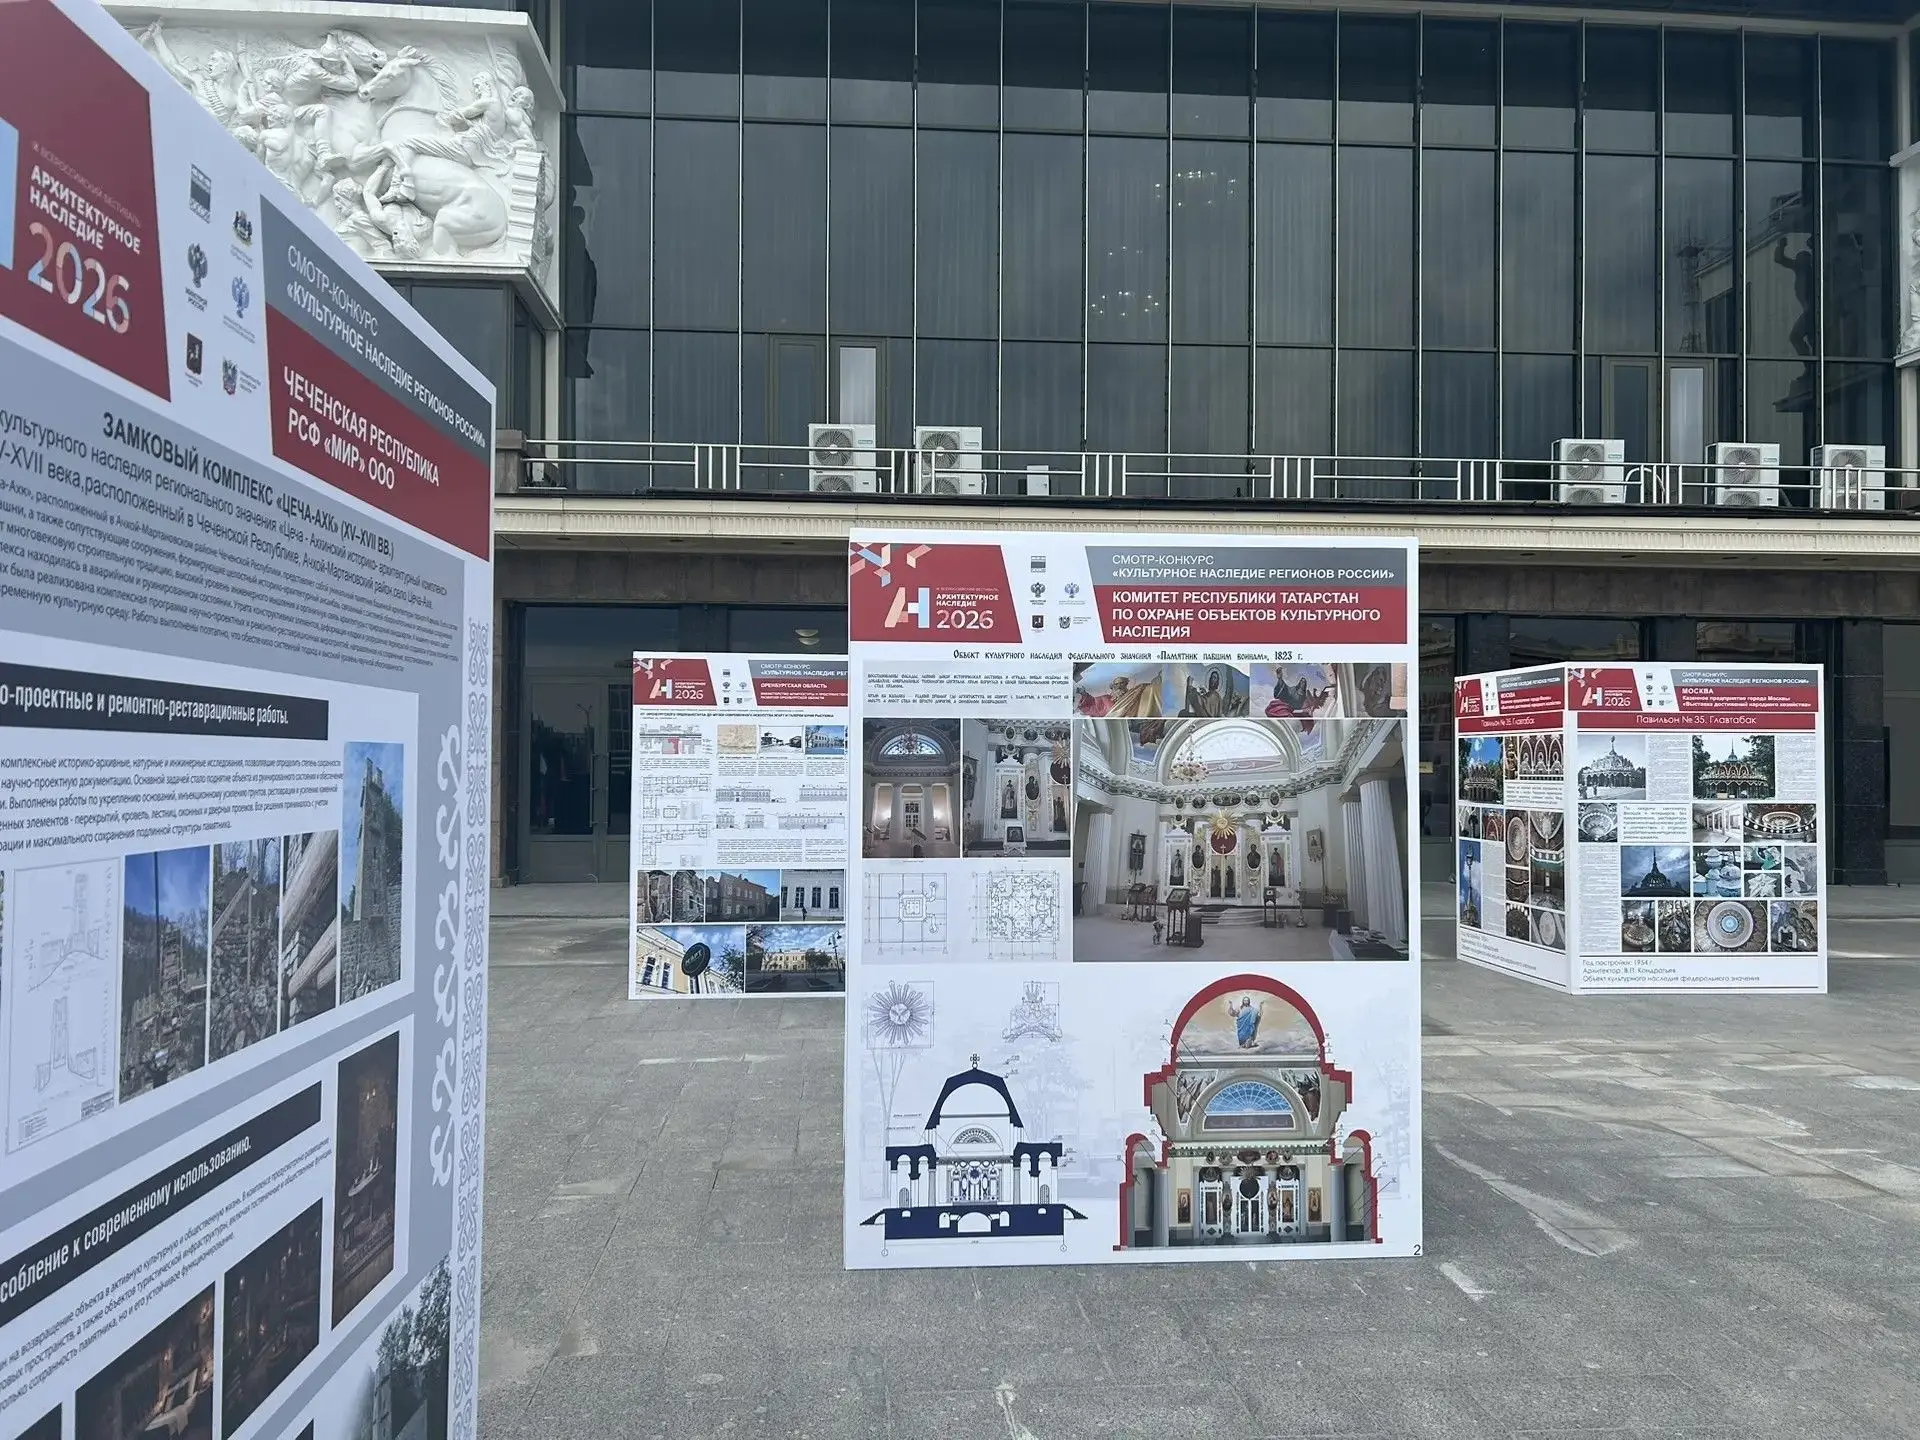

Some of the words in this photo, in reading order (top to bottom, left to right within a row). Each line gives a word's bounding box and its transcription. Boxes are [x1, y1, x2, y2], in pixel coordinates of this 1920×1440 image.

[30, 160, 140, 256] АРХИТЕКТУРНОЕ
[30, 184, 104, 253] НАСЛЕДИЕ
[27, 216, 129, 336] 2026
[287, 241, 377, 339] СМОТР-КОНКУРС
[287, 274, 363, 355] «КУЛЬТУРНОЕ
[365, 338, 412, 397] НАСЛЕДИЕ
[413, 378, 454, 426] РЕГИОНОВ
[455, 411, 485, 450] РОССИИ»
[284, 365, 366, 443] ЧЕЧЕНСКАЯ
[369, 422, 438, 487] РЕСПУБЛИКА
[287, 406, 320, 449] РСФ
[323, 428, 365, 474] «МИР»
[368, 454, 394, 491] ООО
[103, 409, 198, 475] ЗАМКОВЫЙ
[202, 455, 272, 507] КОМПЛЕКС
[276, 490, 337, 535] «ЦЕЧА-АХК»
[90, 446, 151, 487] наследия
[155, 472, 233, 518] регионального
[236, 505, 274, 531] значения
[36, 489, 107, 525] расположенный
[36, 511, 63, 528] также
[187, 512, 193, 527] в
[196, 512, 248, 546] Чеченской
[1112, 554, 1214, 565] СМОТР-КОНКУРС
[1112, 568, 1197, 578] «КУЛЬТУРНОЕ
[1200, 569, 1266, 579] НАСЛЕДИЕ
[1269, 569, 1334, 579] РЕГИОНОВ
[1338, 569, 1394, 579] РОССИИ»
[1112, 591, 1179, 603] КОМИТЕТ
[1182, 591, 1276, 604] РЕСПУБЛИКИ
[1280, 592, 1359, 604] ТАТАРСТАН
[936, 609, 994, 629] 2026
[1112, 608, 1133, 620] ПО
[1137, 608, 1194, 620] ОХРАНЕ
[1198, 609, 1276, 621] ОБЪЕКТОВ
[1280, 609, 1381, 621] КУЛЬТУРНОГО
[1112, 626, 1190, 639] НАСЛЕДИЯ
[1274, 651, 1293, 661] 1823
[675, 690, 704, 700] 2026
[1604, 697, 1631, 706] 2026
[97, 693, 104, 712] и
[108, 692, 254, 725] ремонтно-реставрационные
[256, 703, 288, 728] работы.
[1636, 715, 1680, 724] Павильон
[1681, 716, 1693, 724] №
[1694, 716, 1707, 724] 35.
[1709, 715, 1757, 724] Главтабак
[1, 758, 55, 769] комплексные
[73, 1237, 80, 1258] к
[84, 1182, 170, 1252] современному
[173, 1133, 251, 1195] использованию.
[1413, 1244, 1421, 1256] 2
